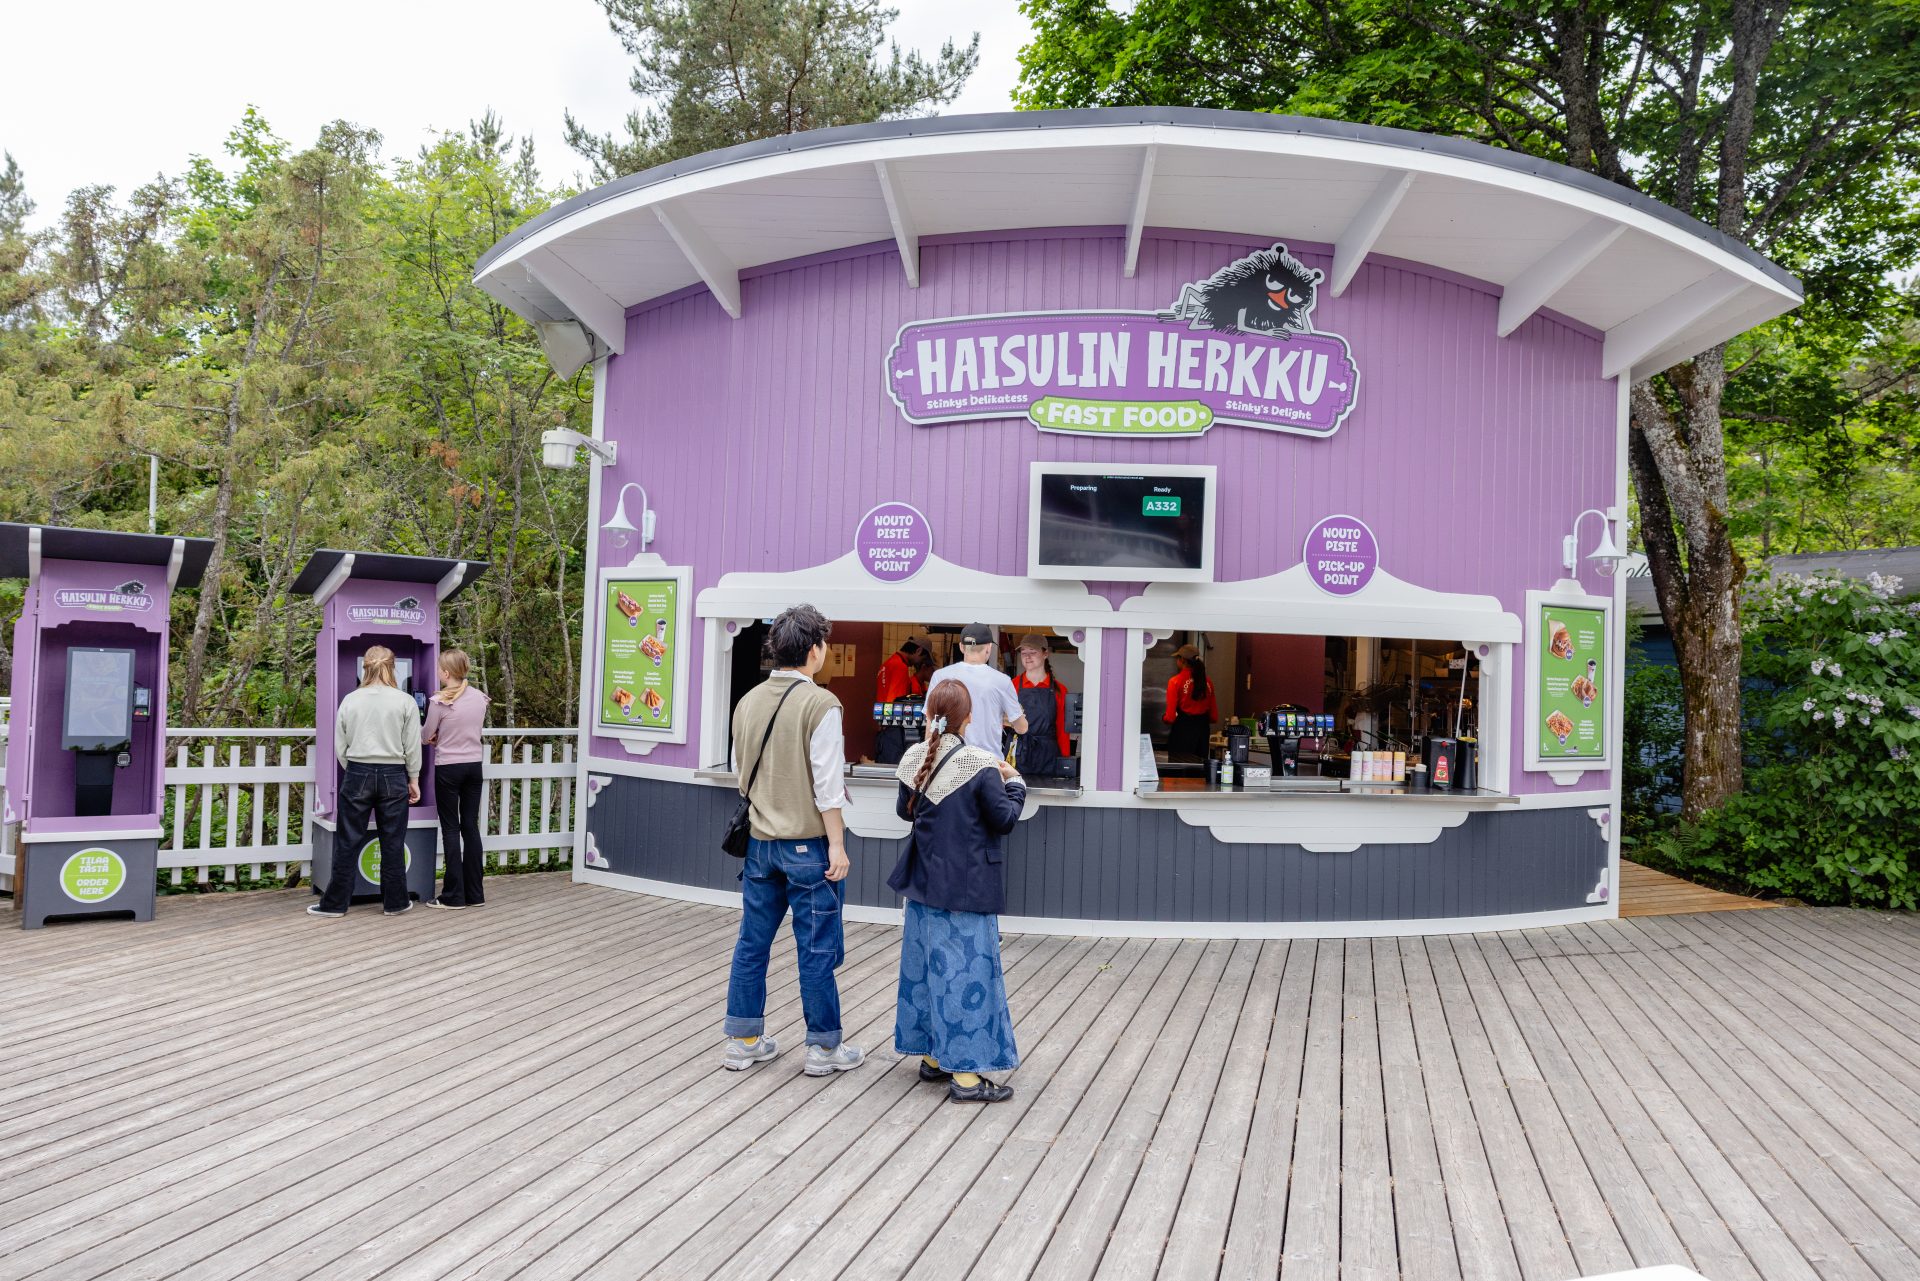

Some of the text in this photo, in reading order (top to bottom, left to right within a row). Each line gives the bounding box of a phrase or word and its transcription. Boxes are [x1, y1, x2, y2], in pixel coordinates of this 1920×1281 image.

[916, 330, 1329, 406] HAISULIN HERKKU
[926, 394, 1028, 409] Stinkys Delikatess
[1047, 402, 1197, 428] FAST FOOD
[1225, 400, 1312, 421] Stinky's Delight
[1070, 484, 1098, 492] Preparing
[1153, 486, 1172, 494] Ready
[1146, 501, 1177, 511] A332
[874, 515, 914, 526] NOUTO
[877, 528, 910, 539] PISTE
[1322, 527, 1361, 540] NOUTO
[1325, 540, 1358, 553] PISTE
[869, 548, 917, 559] PICK-UP
[874, 560, 911, 572] POINT
[1318, 560, 1365, 573] PICK-UP
[1323, 573, 1359, 586] POINT
[61, 592, 147, 607] HAISULIN HERKKU
[352, 608, 421, 620] HAISULIN HERKKU
[77, 878, 109, 887] ORDER
[79, 887, 104, 895] HERE
